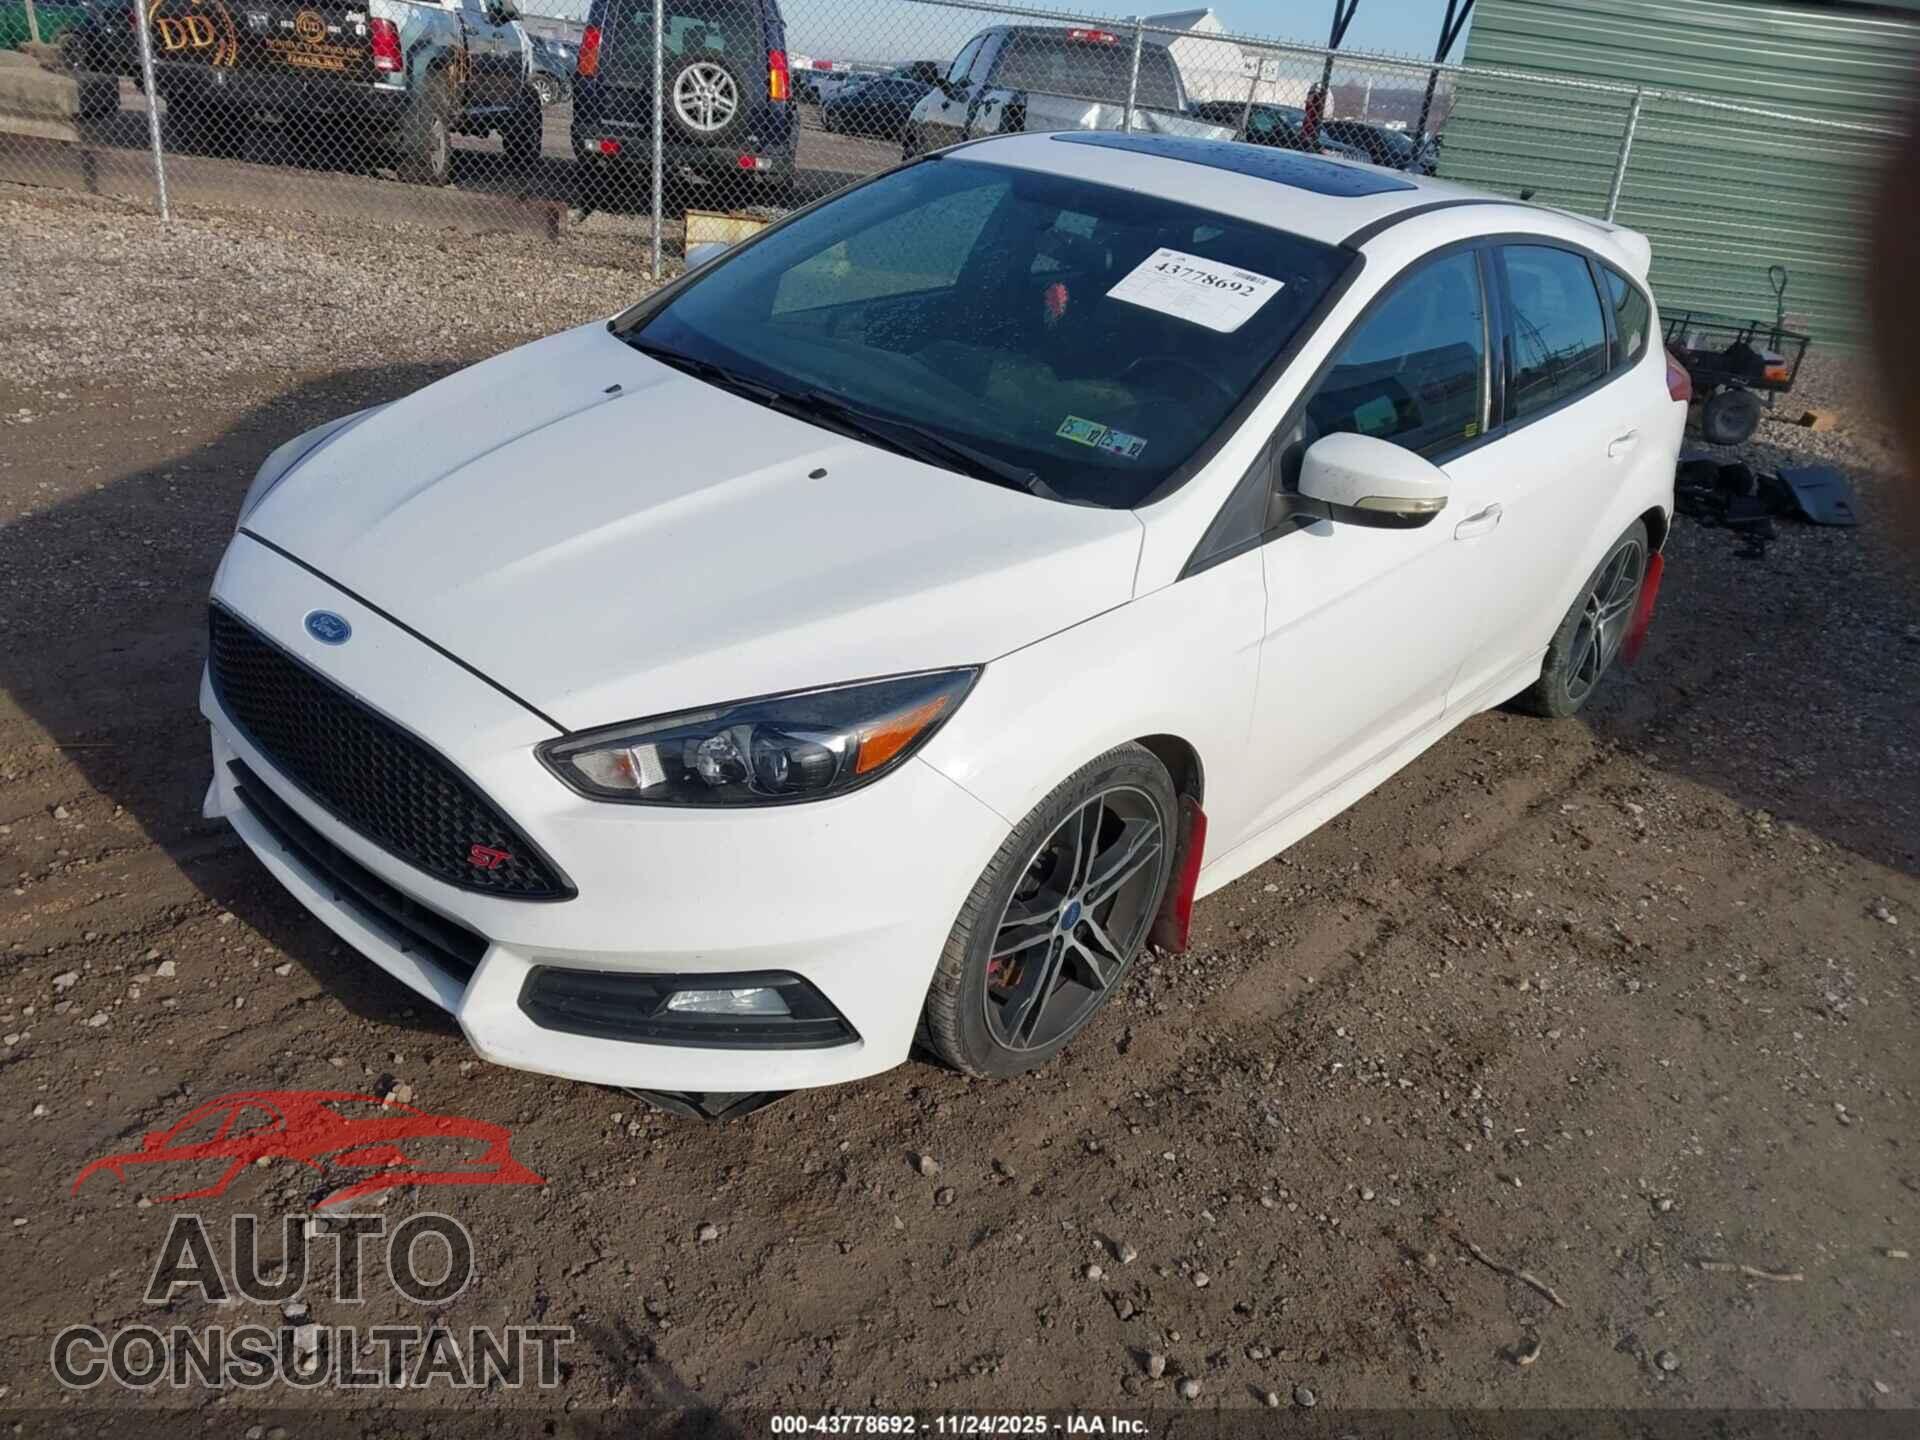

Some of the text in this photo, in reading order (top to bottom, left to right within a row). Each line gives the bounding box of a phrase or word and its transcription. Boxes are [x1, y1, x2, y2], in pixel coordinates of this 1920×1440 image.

[157, 16, 215, 50] DD
[1154, 261, 1256, 298] 43778692
[311, 615, 346, 638] Ford
[466, 843, 513, 870] ST
